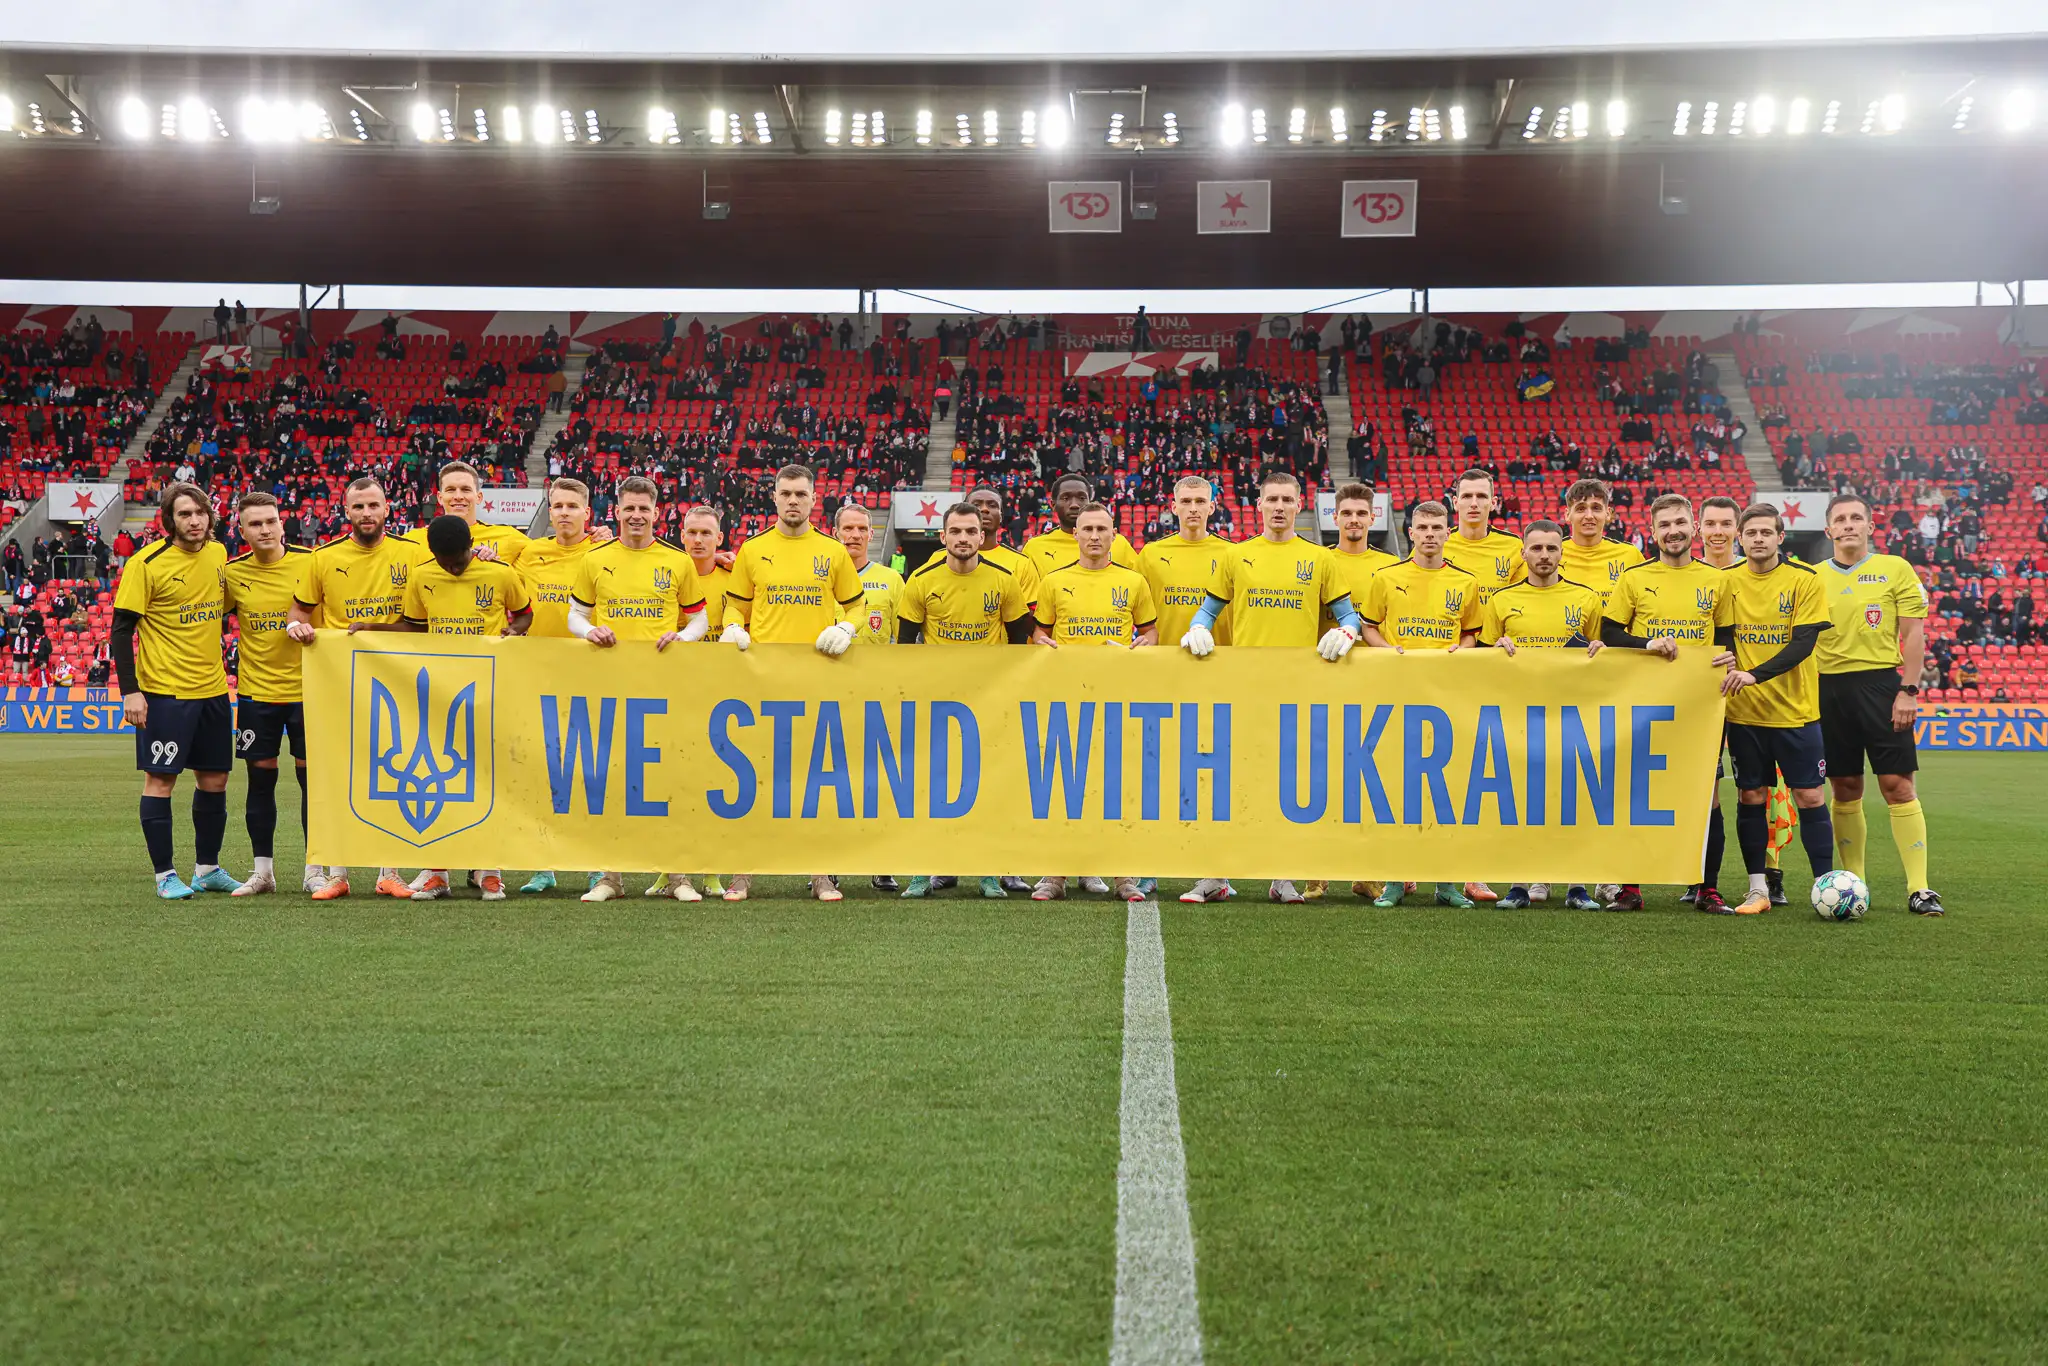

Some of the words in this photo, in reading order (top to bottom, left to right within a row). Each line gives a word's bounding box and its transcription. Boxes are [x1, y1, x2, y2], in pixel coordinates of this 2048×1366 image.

[1115, 316, 1190, 329] TRUNA
[538, 592, 569, 604] UKRAI
[768, 594, 822, 606] UKRAINE
[1165, 596, 1206, 606] UKRAI
[1248, 597, 1302, 609] UKRAINE
[194, 601, 215, 610] STAND
[346, 604, 402, 618] UKRAINE
[180, 609, 223, 624] UKRAIN
[608, 608, 664, 618] UKRAINE
[250, 620, 287, 631] UKRA
[1068, 626, 1122, 636] UKRAINE
[938, 628, 989, 641] UKRAINE
[1398, 626, 1453, 640] UKRAINE
[20, 704, 74, 729] WE
[151, 740, 178, 765] 99
[540, 694, 669, 817] WE
[706, 698, 981, 820] STAND
[1020, 702, 1232, 822] WITH
[1278, 703, 1676, 826] UKRAINE
